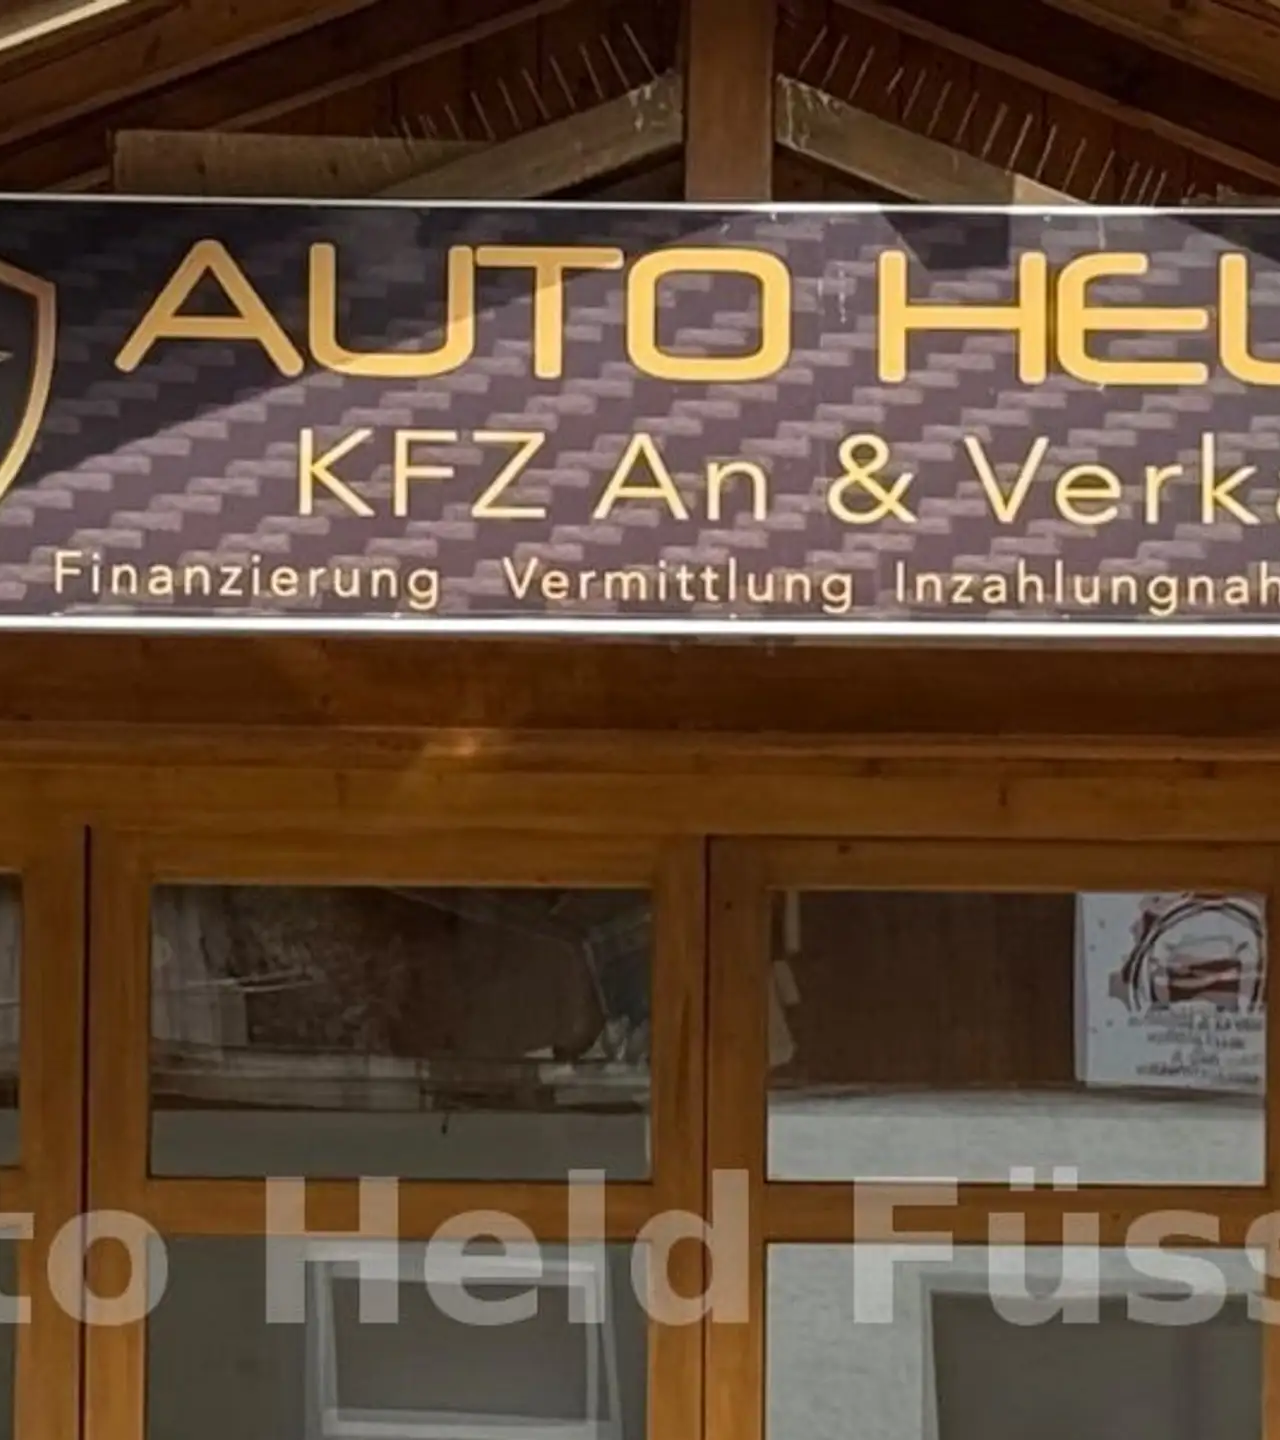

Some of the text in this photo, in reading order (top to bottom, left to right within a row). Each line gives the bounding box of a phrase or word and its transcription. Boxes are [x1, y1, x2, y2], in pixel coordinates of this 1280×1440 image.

[114, 239, 792, 384] AUTO
[298, 428, 547, 520] KFZ
[591, 432, 767, 521] An
[827, 433, 918, 525] &
[53, 551, 440, 609] Finanzierung
[503, 556, 853, 614] Vermittlung
